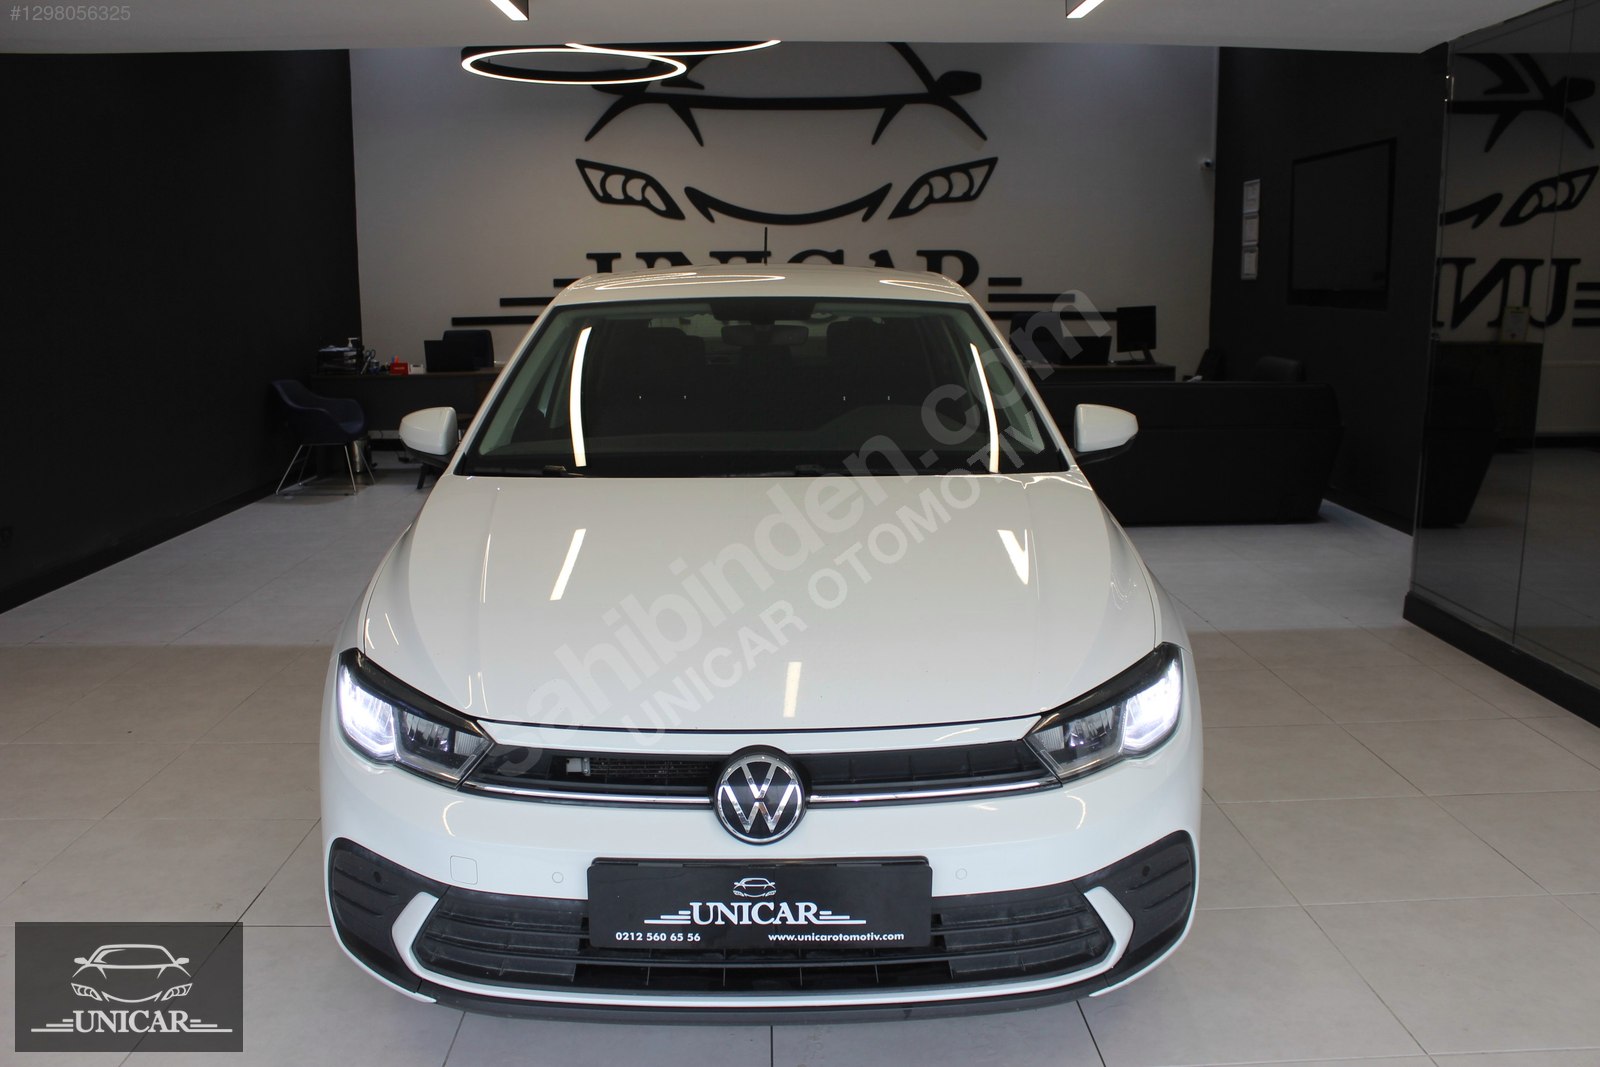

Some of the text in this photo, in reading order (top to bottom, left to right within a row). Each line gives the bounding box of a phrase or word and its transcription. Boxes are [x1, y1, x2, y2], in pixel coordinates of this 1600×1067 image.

[689, 902, 820, 925] UNICAR
[615, 931, 905, 942] 0212 560 65 56 www.unicarotomotiv.com
